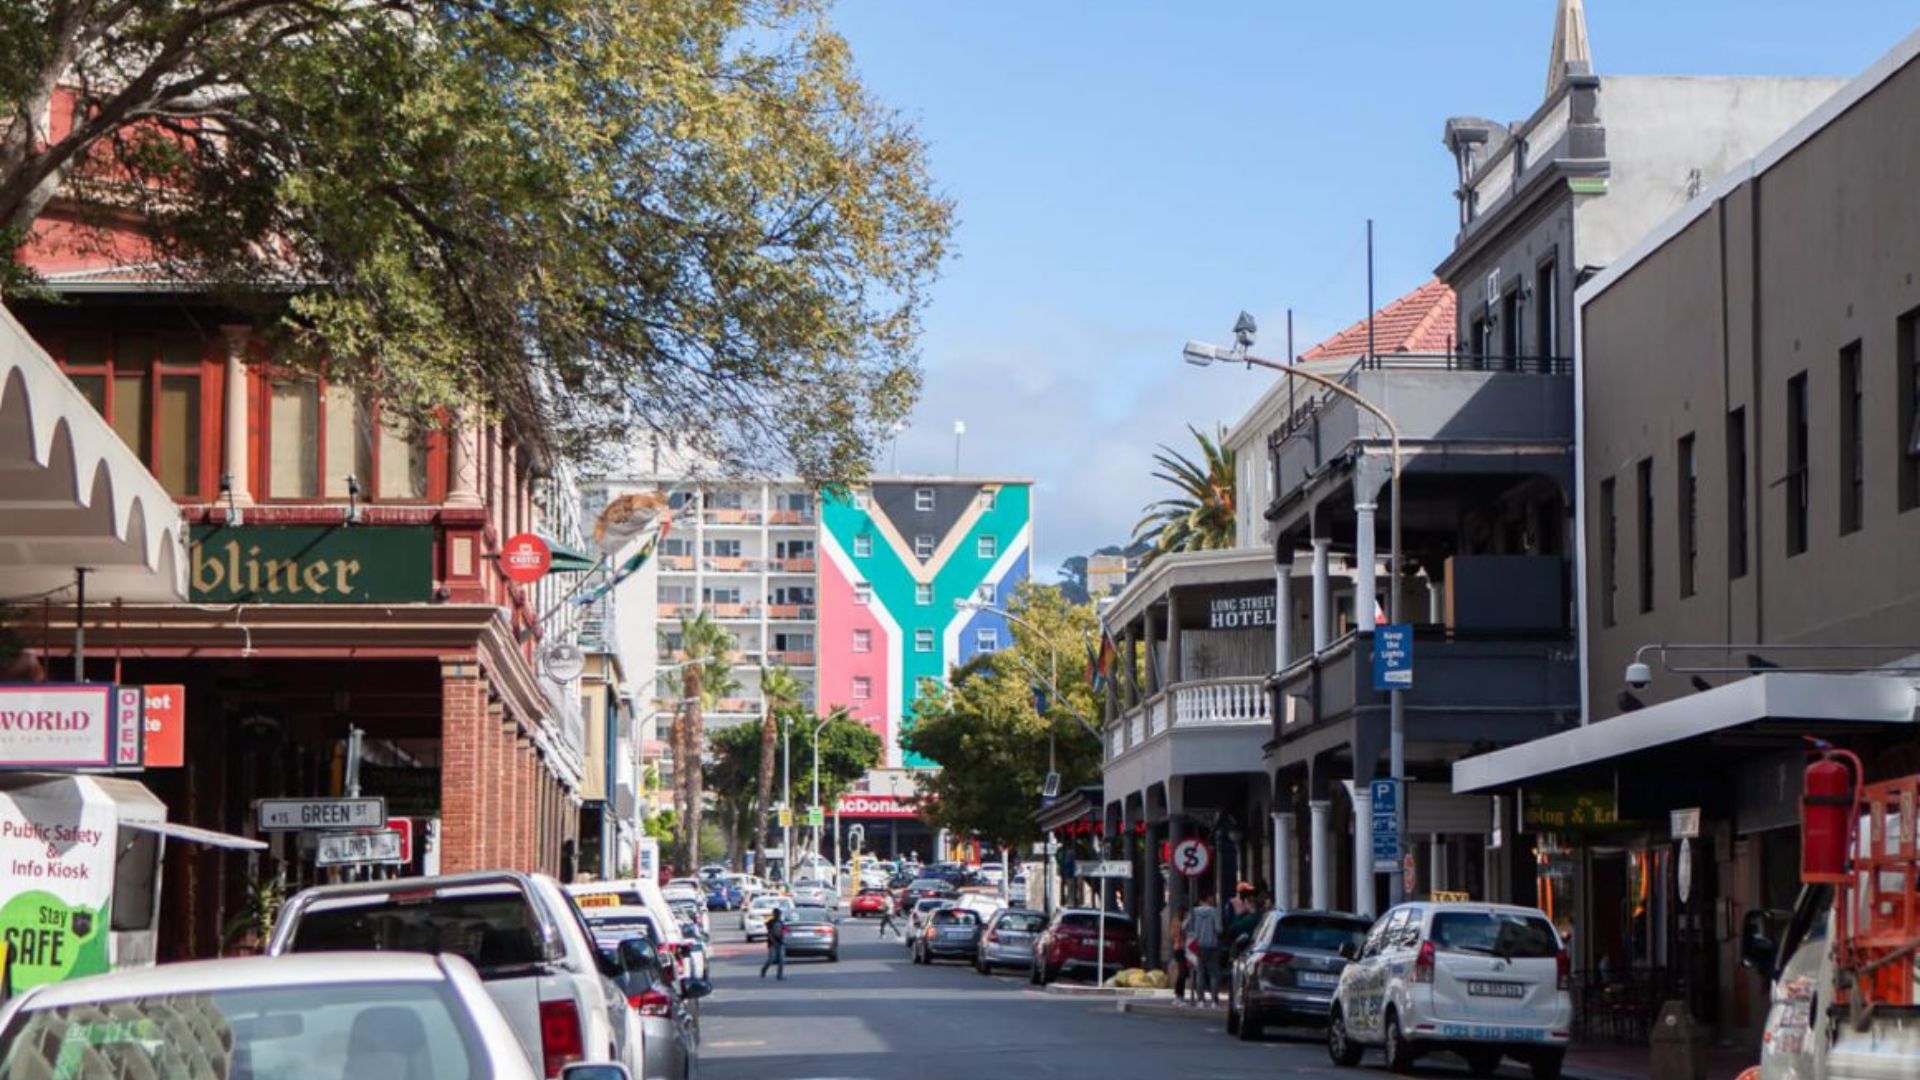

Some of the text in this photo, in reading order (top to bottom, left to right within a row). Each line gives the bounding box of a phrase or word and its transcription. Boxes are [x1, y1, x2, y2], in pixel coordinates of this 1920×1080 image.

[191, 539, 361, 594] bliner
[1210, 595, 1275, 611] LONG STREET
[1210, 609, 1278, 628] HOTEL
[121, 691, 136, 762] OPEN
[301, 804, 350, 824] GREEN
[3, 820, 102, 847] Public Safety
[46, 841, 58, 859] &
[12, 859, 89, 879] Info Kiosk
[39, 905, 68, 929] Stay
[5, 926, 65, 967] SAFE
